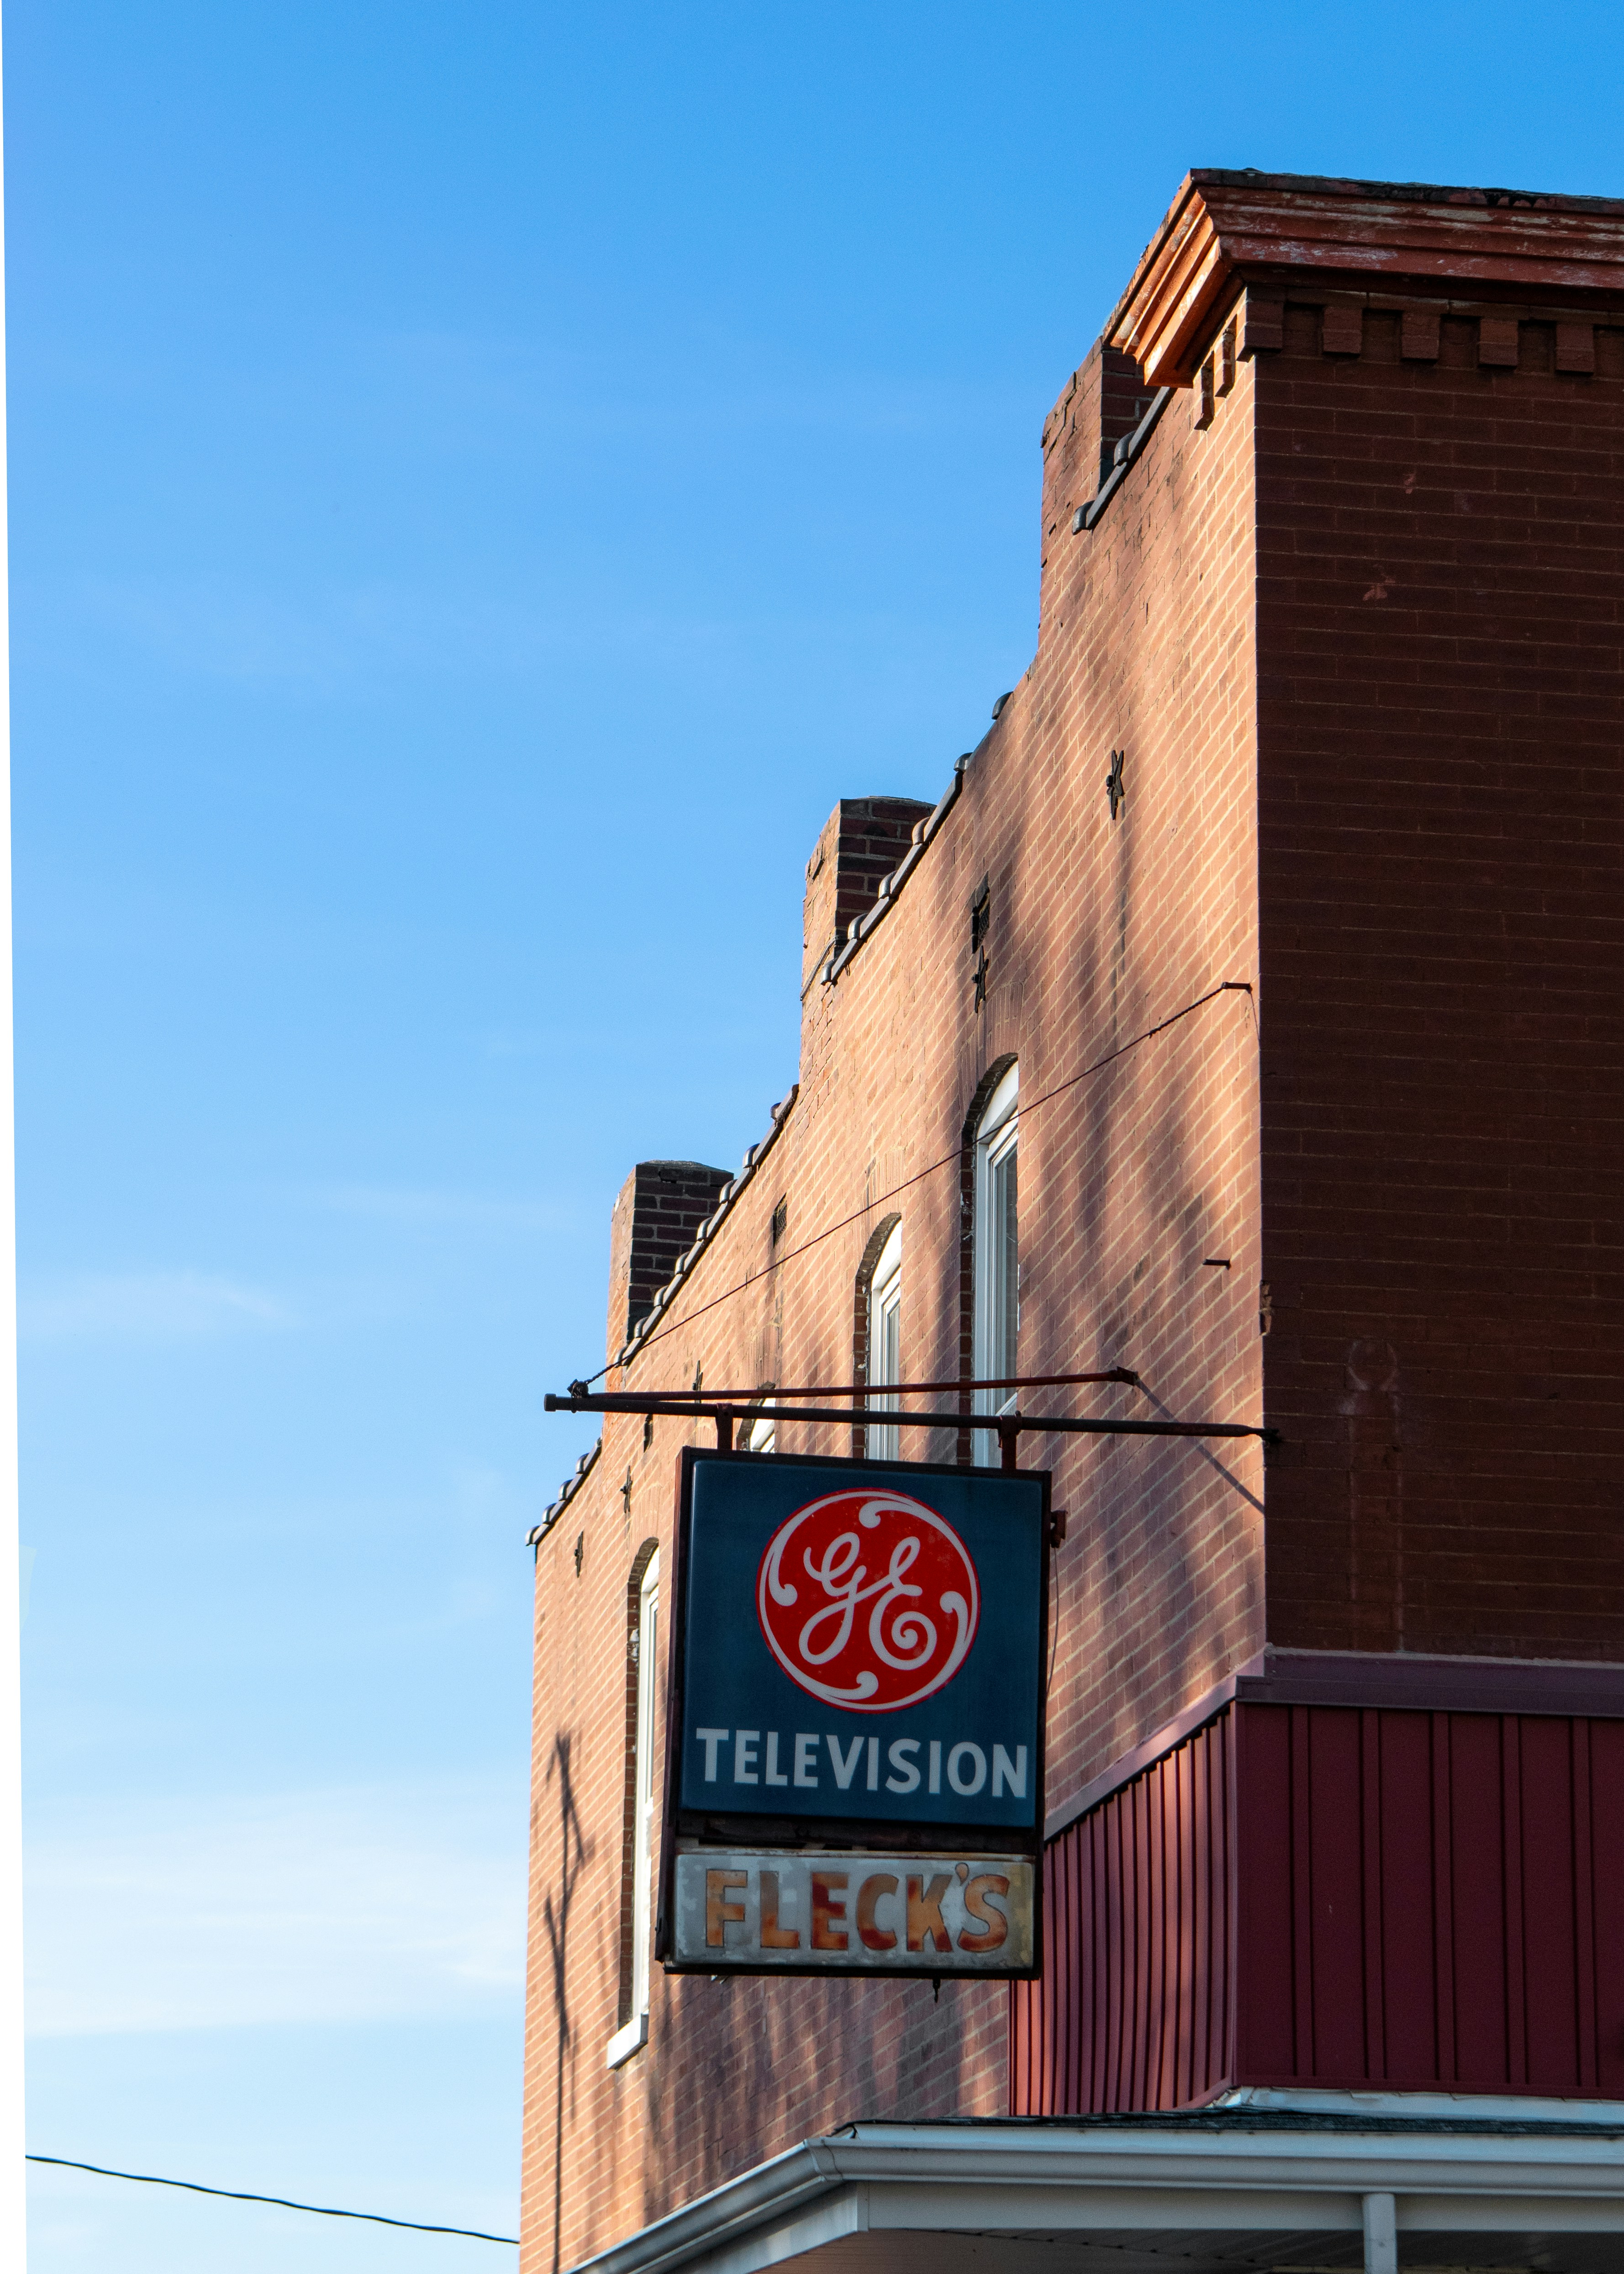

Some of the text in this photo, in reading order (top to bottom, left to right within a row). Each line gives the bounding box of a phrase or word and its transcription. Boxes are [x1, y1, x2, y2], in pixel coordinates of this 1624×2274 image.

[798, 1532, 937, 1670] GE
[696, 1728, 1027, 1798] TELEVISION
[706, 1862, 1010, 1952] FLECK'S
